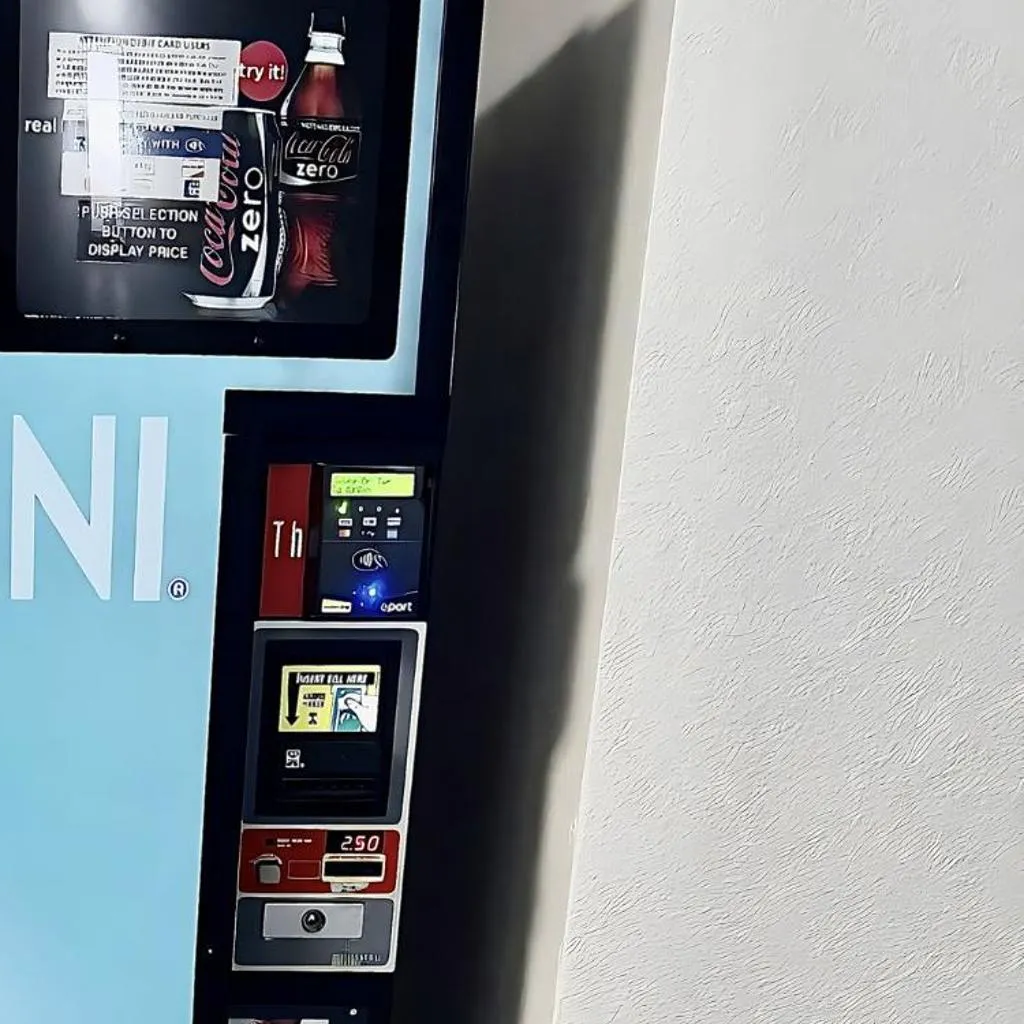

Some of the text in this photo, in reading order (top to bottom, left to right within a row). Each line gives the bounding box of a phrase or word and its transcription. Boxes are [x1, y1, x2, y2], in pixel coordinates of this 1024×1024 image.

[158, 40, 182, 50] CARD
[237, 63, 285, 82] try it!
[24, 118, 57, 134] real
[152, 138, 180, 150] WITH
[296, 163, 338, 179] zero
[121, 206, 199, 222] SELECTION
[241, 166, 264, 253] zero
[101, 225, 177, 240] BUTTON TO
[87, 243, 189, 259] DISPLAY PRICE
[340, 835, 380, 852] 2.50
